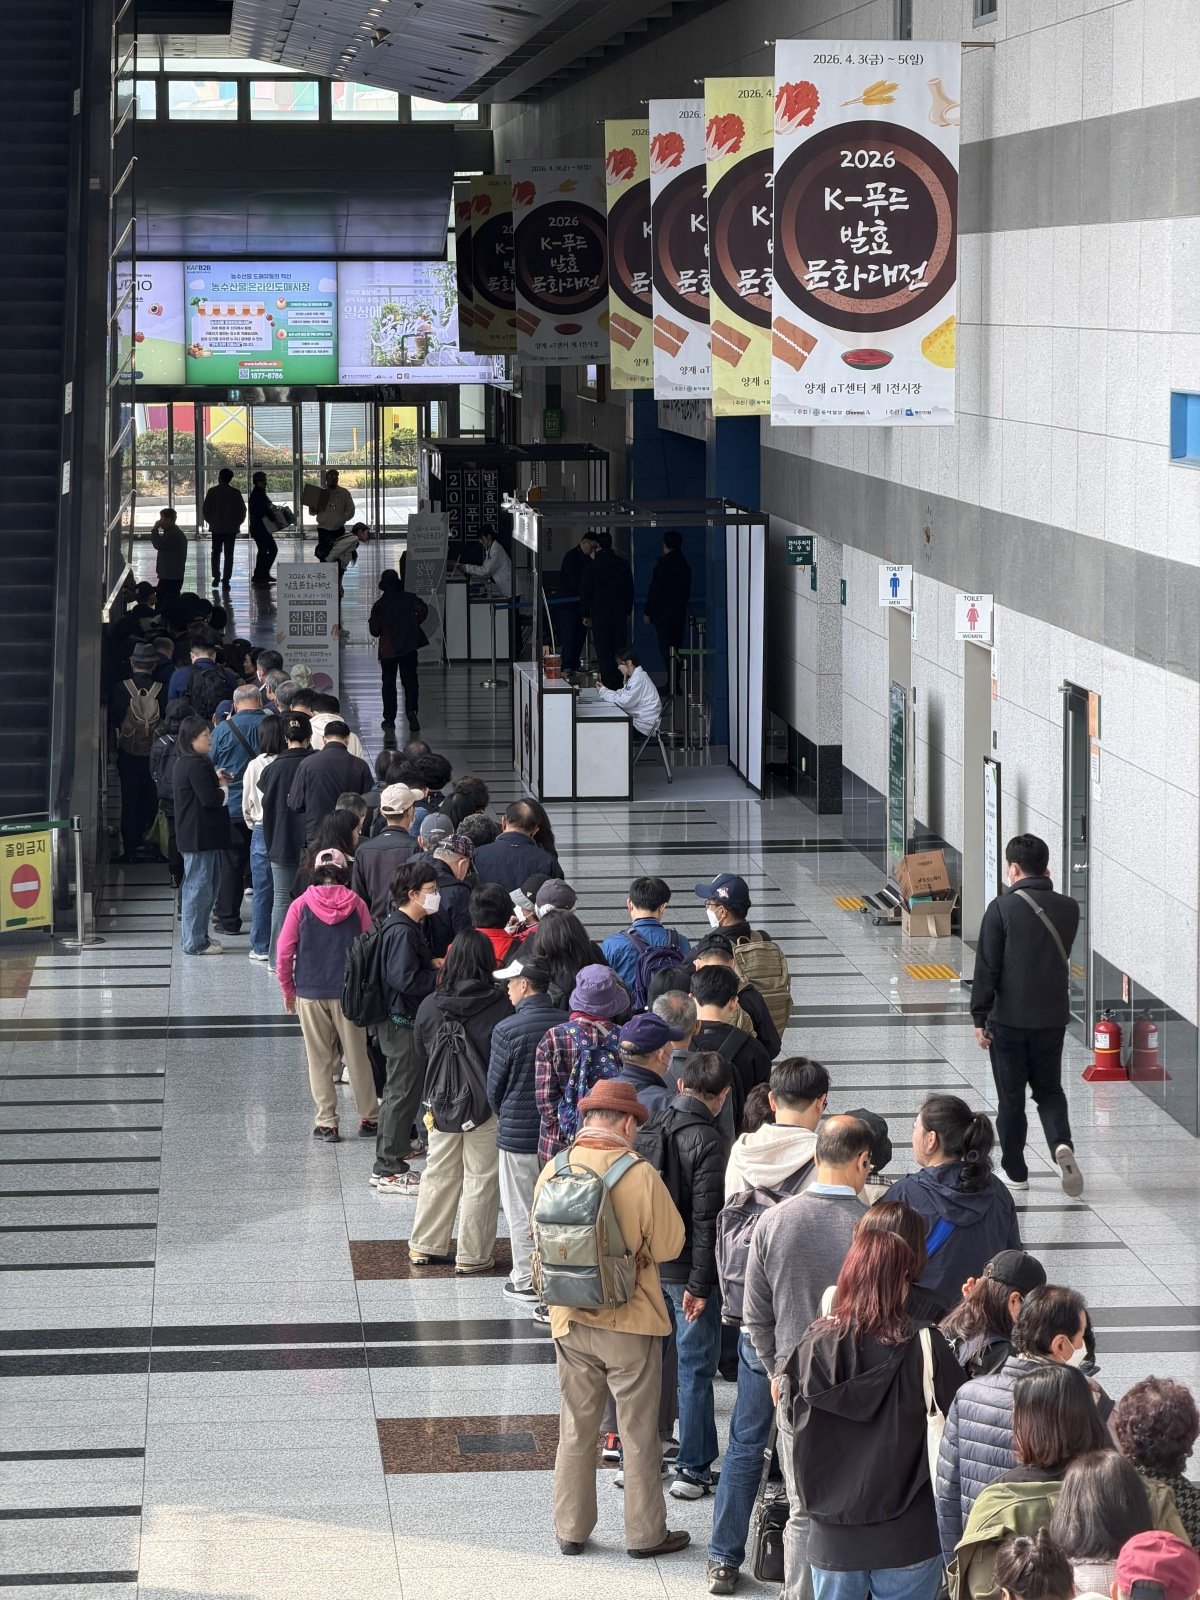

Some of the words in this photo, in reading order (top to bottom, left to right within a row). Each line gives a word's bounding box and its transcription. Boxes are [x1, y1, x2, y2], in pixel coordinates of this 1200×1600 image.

[813, 54, 842, 64] 2026.
[845, 54, 855, 65] 4.
[858, 54, 884, 66] 3(금)
[898, 54, 924, 66] 5(일)
[840, 150, 896, 168] 2026
[824, 182, 910, 216] K-푸드
[548, 216, 579, 227] 2026
[540, 233, 588, 251] K-푸드
[840, 219, 893, 256] 발효
[550, 254, 580, 274] 발효
[532, 274, 600, 294] 문화대전
[803, 258, 929, 292] 문화대전
[211, 282, 247, 292] 농수산물
[248, 282, 310, 292] 온라인도매시장
[742, 376, 760, 386] 양재
[804, 382, 826, 394] 양재
[830, 383, 866, 394] aT센터
[870, 383, 882, 394] 제
[6, 840, 46, 858] 출입금지
